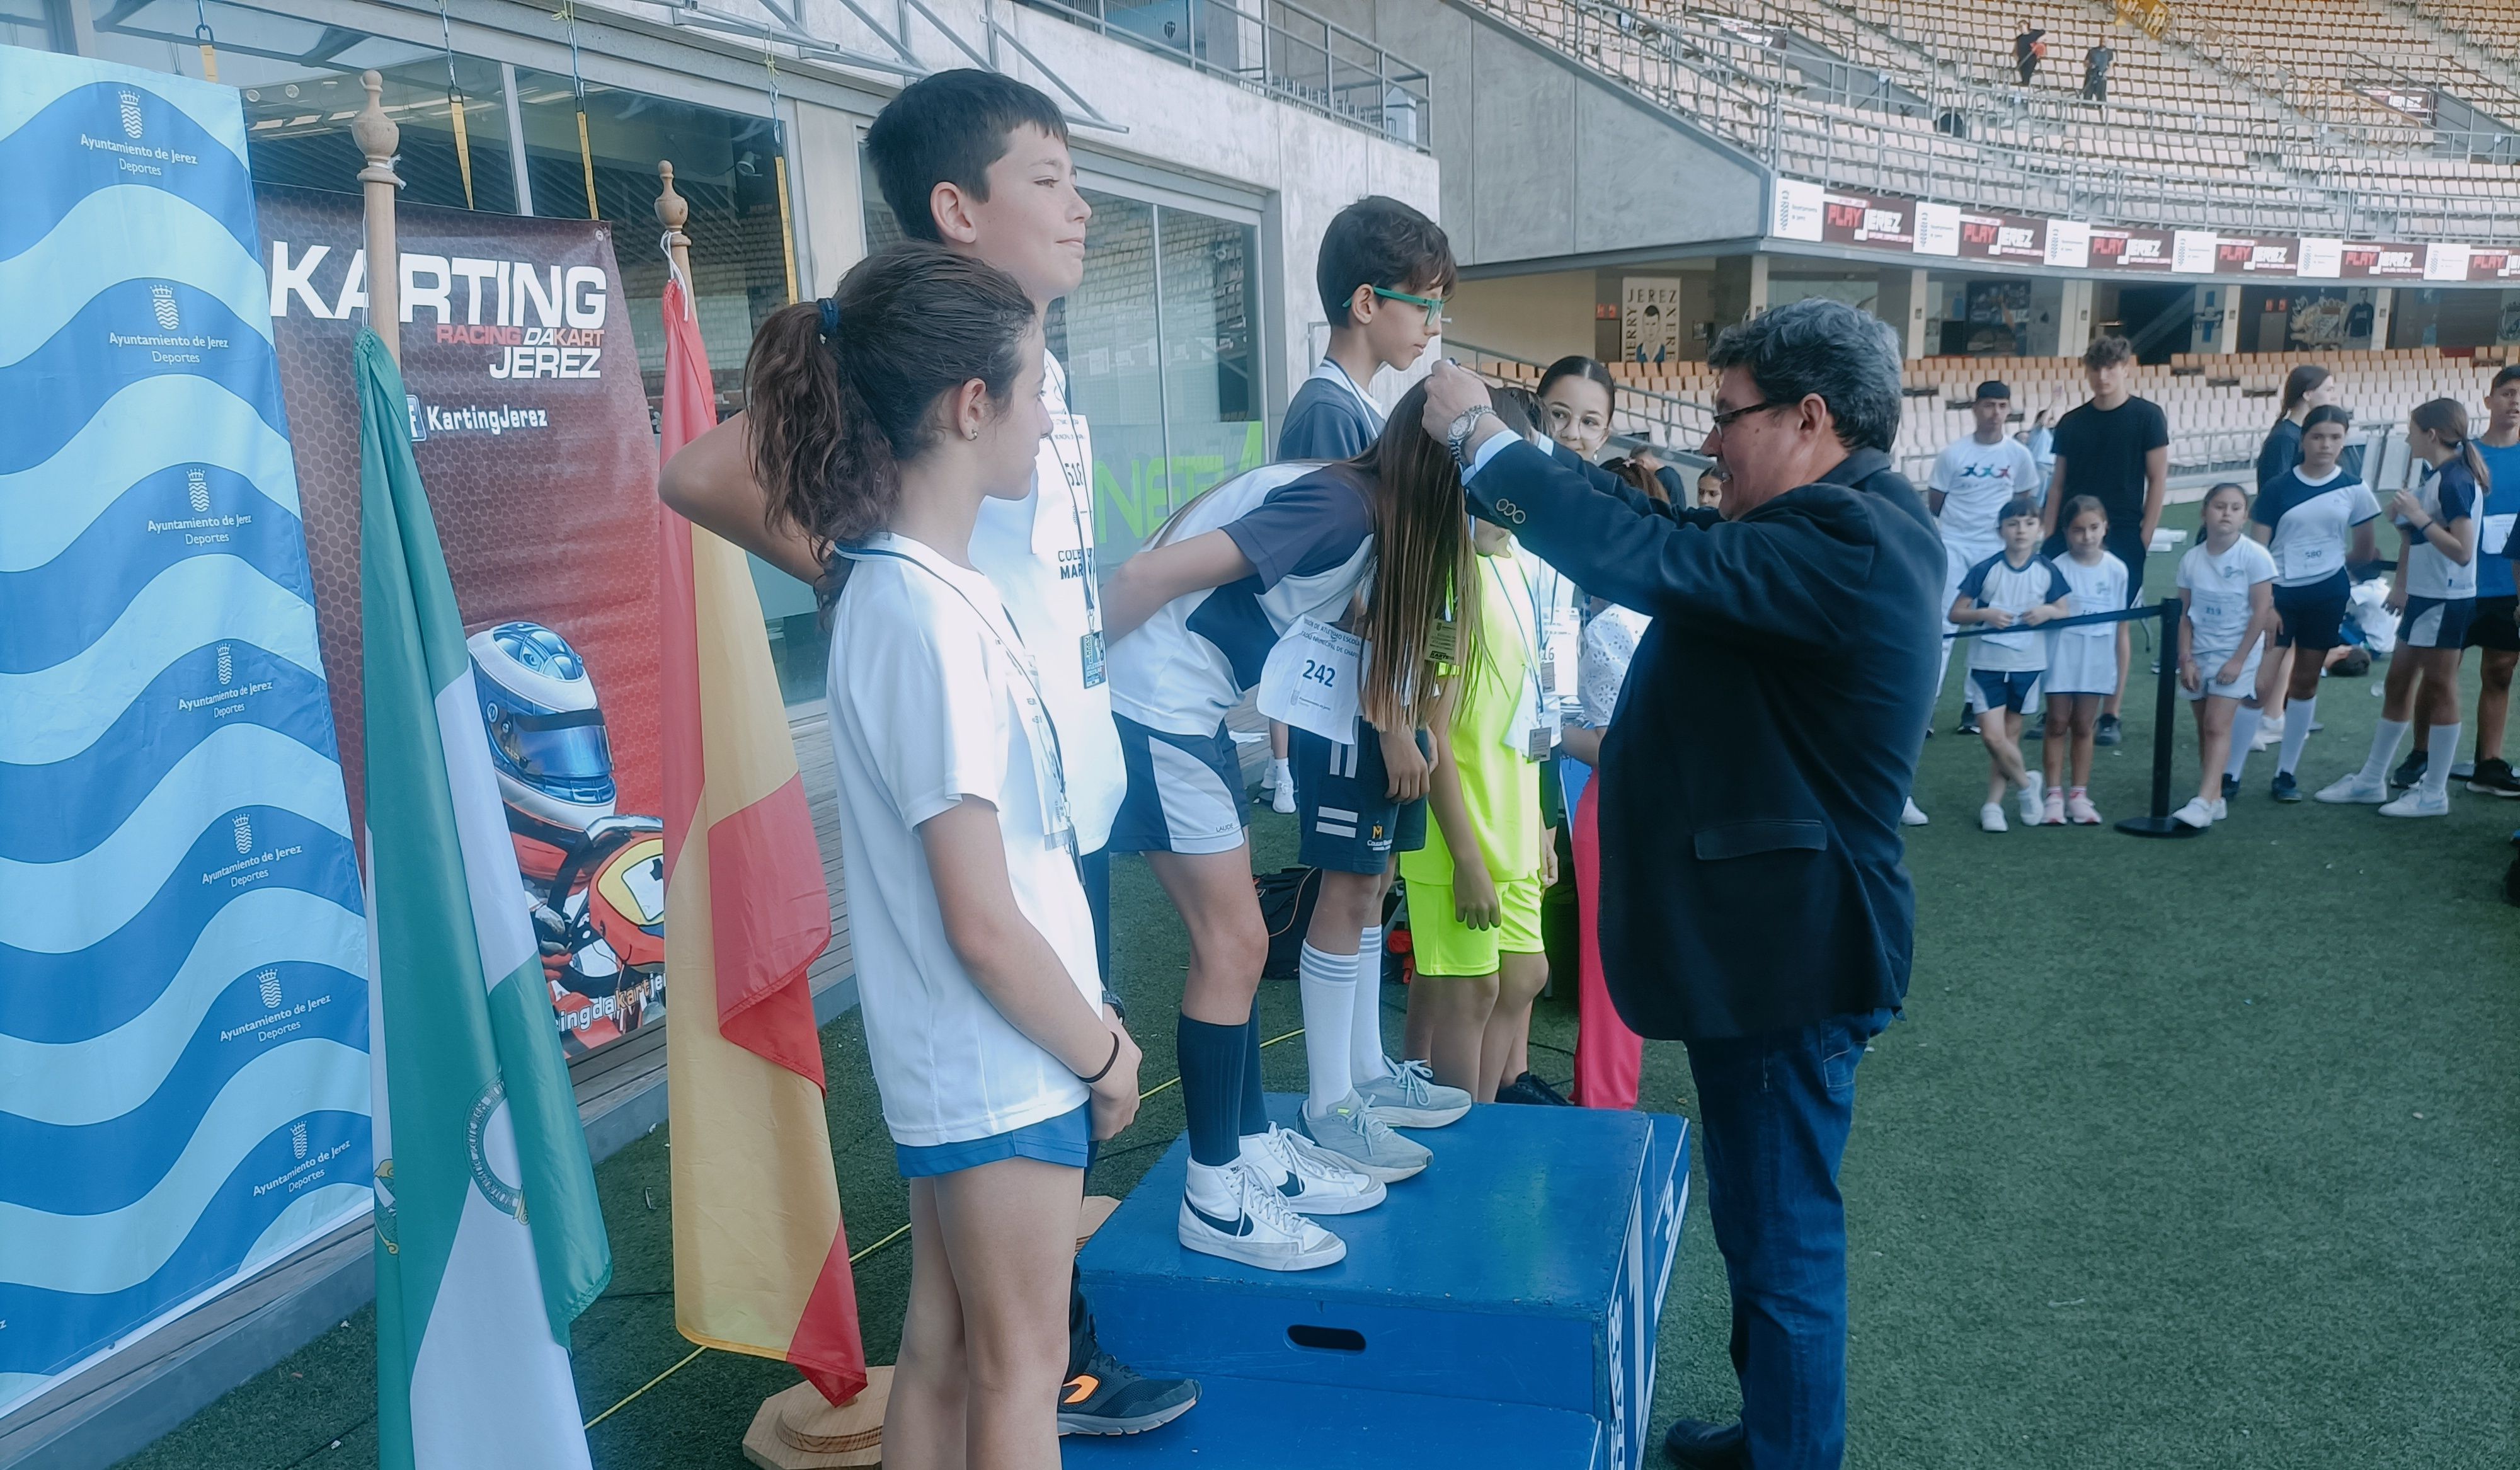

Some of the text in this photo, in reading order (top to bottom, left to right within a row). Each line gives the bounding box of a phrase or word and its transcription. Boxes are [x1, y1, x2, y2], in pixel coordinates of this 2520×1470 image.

[80, 133, 198, 164] Ayuntamiento de Jerez
[119, 158, 162, 176] Deportes
[1828, 204, 1863, 227] PLAY
[1854, 209, 1903, 241] JEREZ
[1964, 224, 1997, 243] PLAY
[1988, 227, 2034, 255] JEREZ
[2093, 238, 2126, 255] PLAY
[2219, 246, 2252, 261] PLAY
[2345, 252, 2378, 266] PLAY
[270, 241, 606, 328] KARTING
[1628, 289, 1677, 303] JEREZ
[109, 331, 229, 349] Ayuntamiento de Jerez
[437, 324, 604, 347] RACING DAKART
[1625, 307, 1637, 362] HERRY
[152, 351, 200, 365] Deportes
[490, 347, 601, 379] JEREZ
[427, 405, 547, 435] KartingJerez
[147, 514, 252, 533] Ayuntamiento de Jerez
[185, 532, 229, 547] Deportes
[1343, 635, 1360, 646] ESCOLA
[1302, 659, 1336, 687] 242
[178, 680, 272, 711] Ayuntamiento de Jerez
[214, 702, 245, 719] Deportes
[202, 844, 302, 885] Ayuntamiento de Jerez
[231, 868, 269, 888] Deportes
[220, 994, 331, 1042] Ayuntamiento de Jerez
[258, 1021, 301, 1043] Deportes
[253, 1140, 351, 1197] Ayuntamiento de Jerez
[288, 1168, 325, 1193] Deportes
